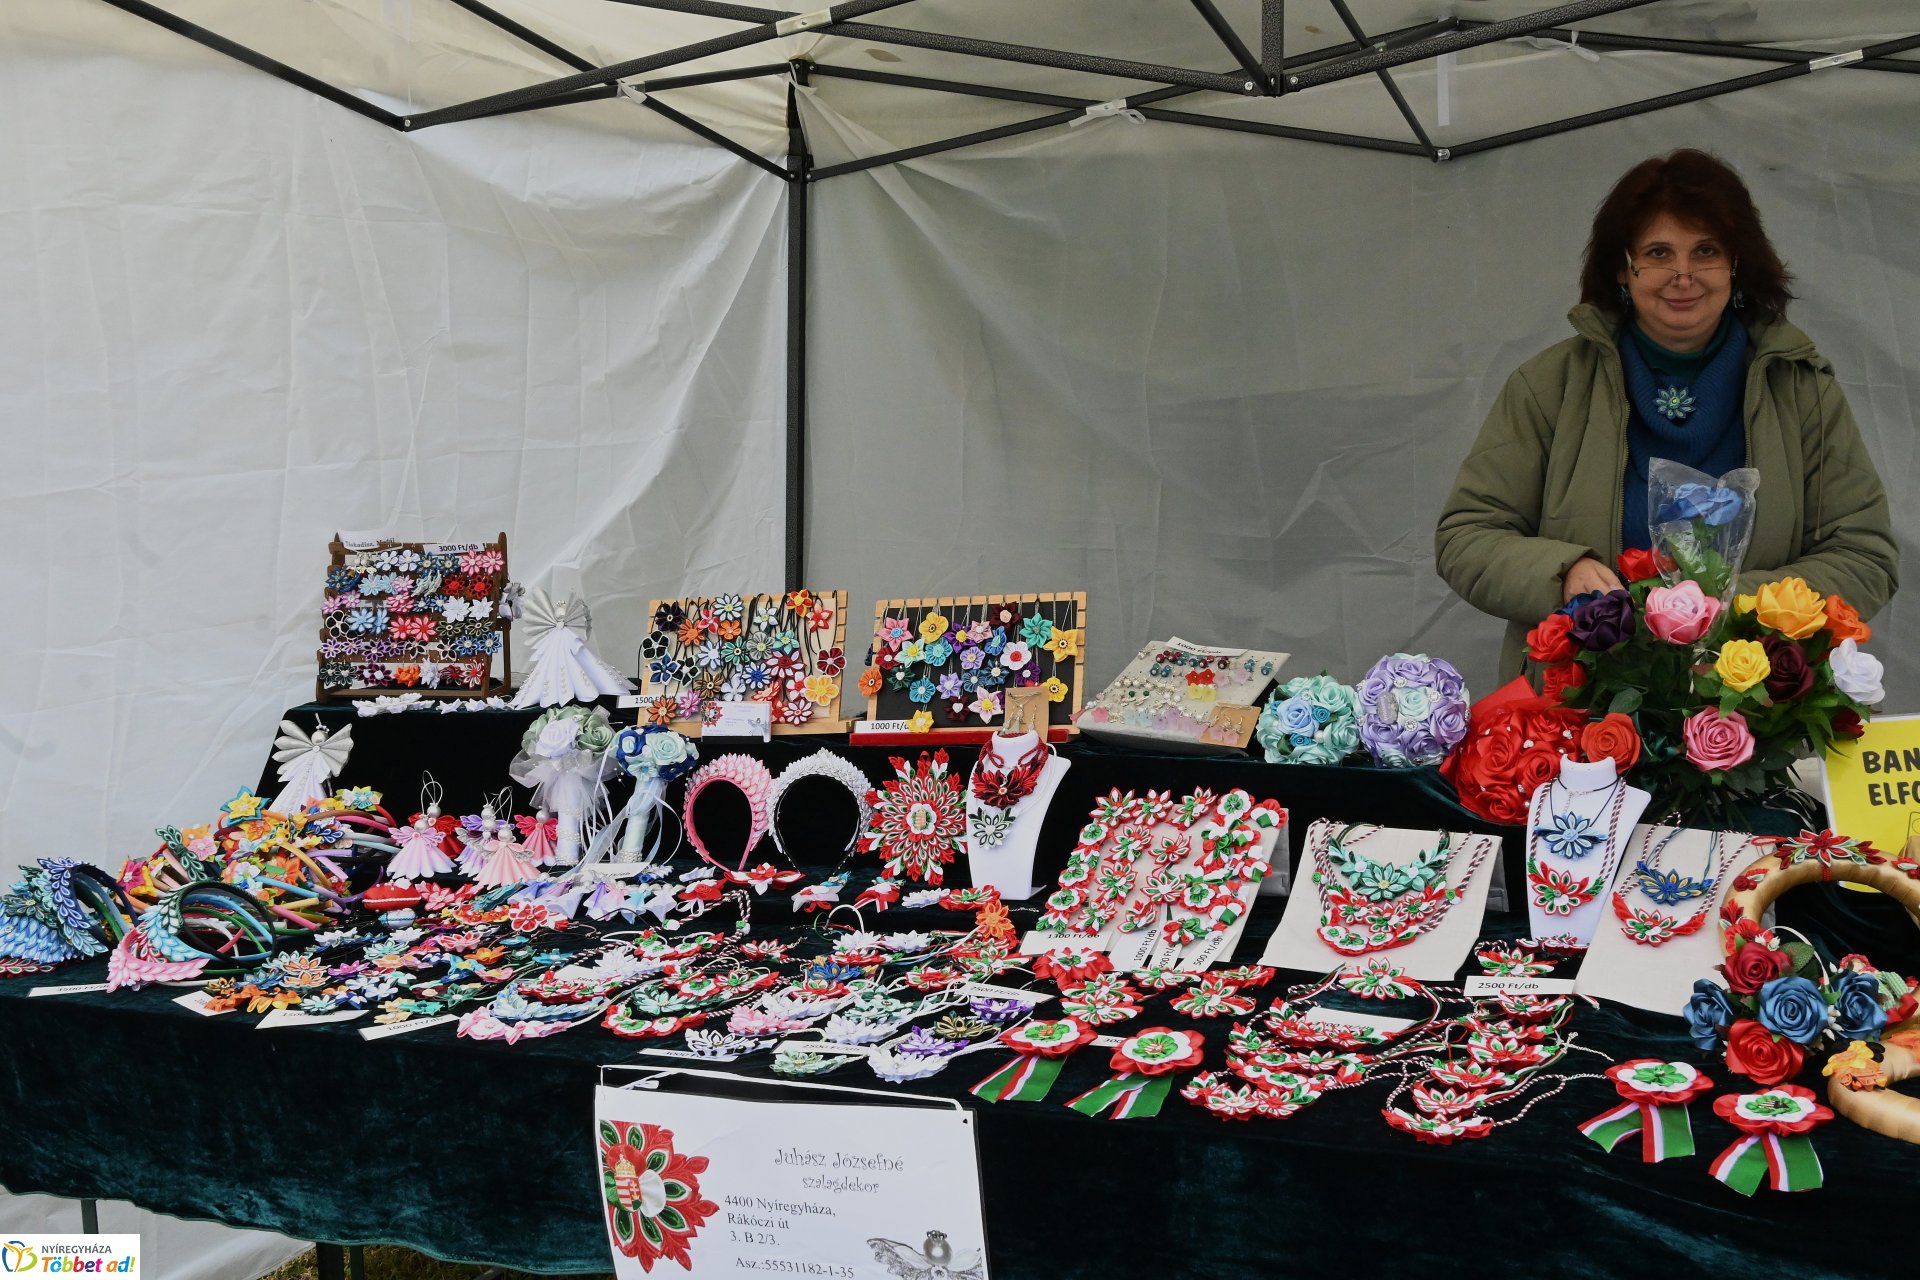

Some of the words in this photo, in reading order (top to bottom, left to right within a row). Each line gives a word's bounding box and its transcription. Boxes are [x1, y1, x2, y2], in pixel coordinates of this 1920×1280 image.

[458, 544, 479, 552] Ft/db
[1177, 642, 1196, 651] 1000
[635, 696, 654, 704] 1500
[871, 722, 890, 730] 1000
[1133, 946, 1148, 961] 1000
[1141, 929, 1157, 946] Ft/db
[1193, 954, 1207, 966] 500
[1206, 936, 1224, 955] Ft/db
[774, 1148, 827, 1167] Juhász
[832, 1152, 905, 1172] Józsefné
[802, 1175, 880, 1194] szalagdekor
[724, 1195, 754, 1208] 4400
[756, 1197, 836, 1217] Nyíregyháza,
[727, 1213, 775, 1229] Rákóczi
[778, 1217, 790, 1229] út
[730, 1230, 741, 1242] 3.
[744, 1231, 754, 1243] B
[758, 1232, 780, 1246] 2/3.
[735, 1257, 854, 1279] Asz.:55531182-1-35
